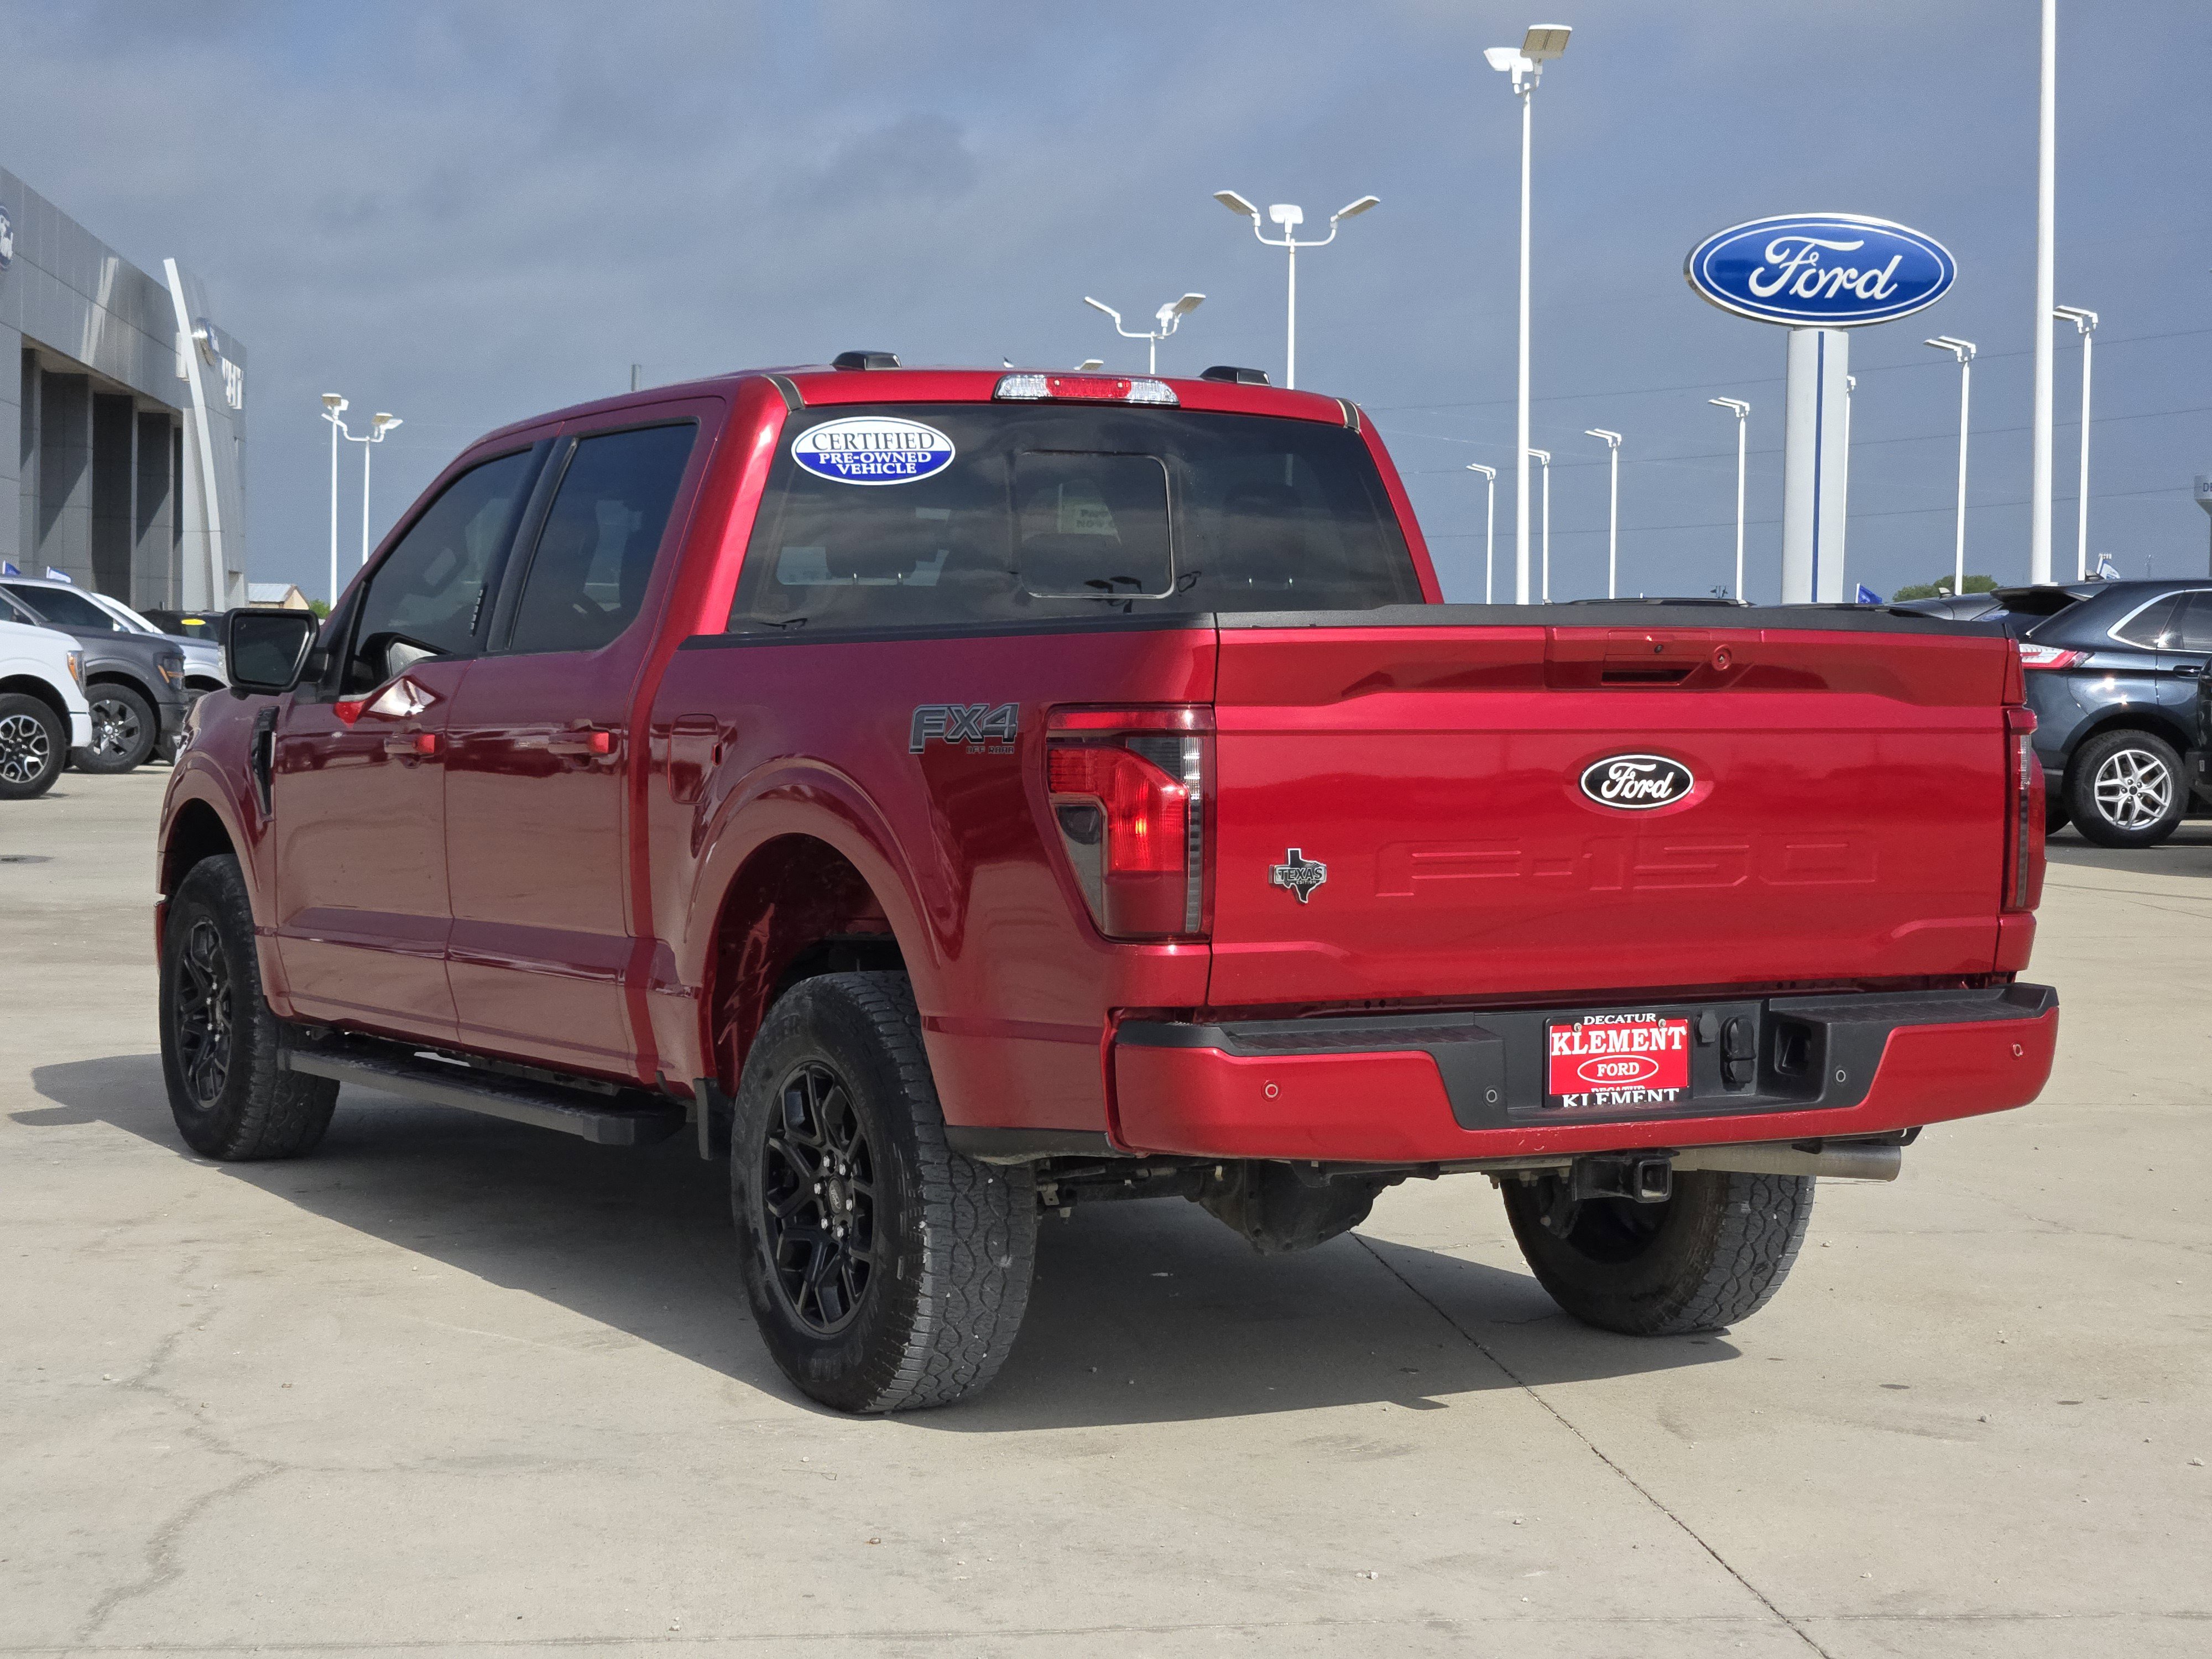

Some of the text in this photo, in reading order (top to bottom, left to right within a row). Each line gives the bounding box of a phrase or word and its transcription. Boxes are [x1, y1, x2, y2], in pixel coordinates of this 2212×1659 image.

[1749, 236, 1903, 299] Ford
[812, 432, 935, 451] CERTIFIED
[818, 452, 931, 464] PRE-OWNED
[836, 462, 917, 475] VEHICLE
[909, 702, 1020, 754] FX4
[1601, 762, 1674, 799] Ford
[1277, 867, 1322, 881] TEXAS
[1583, 1013, 1656, 1025] DECATUR
[1551, 1026, 1687, 1056] KLEMENT
[1597, 1062, 1640, 1077] FORD
